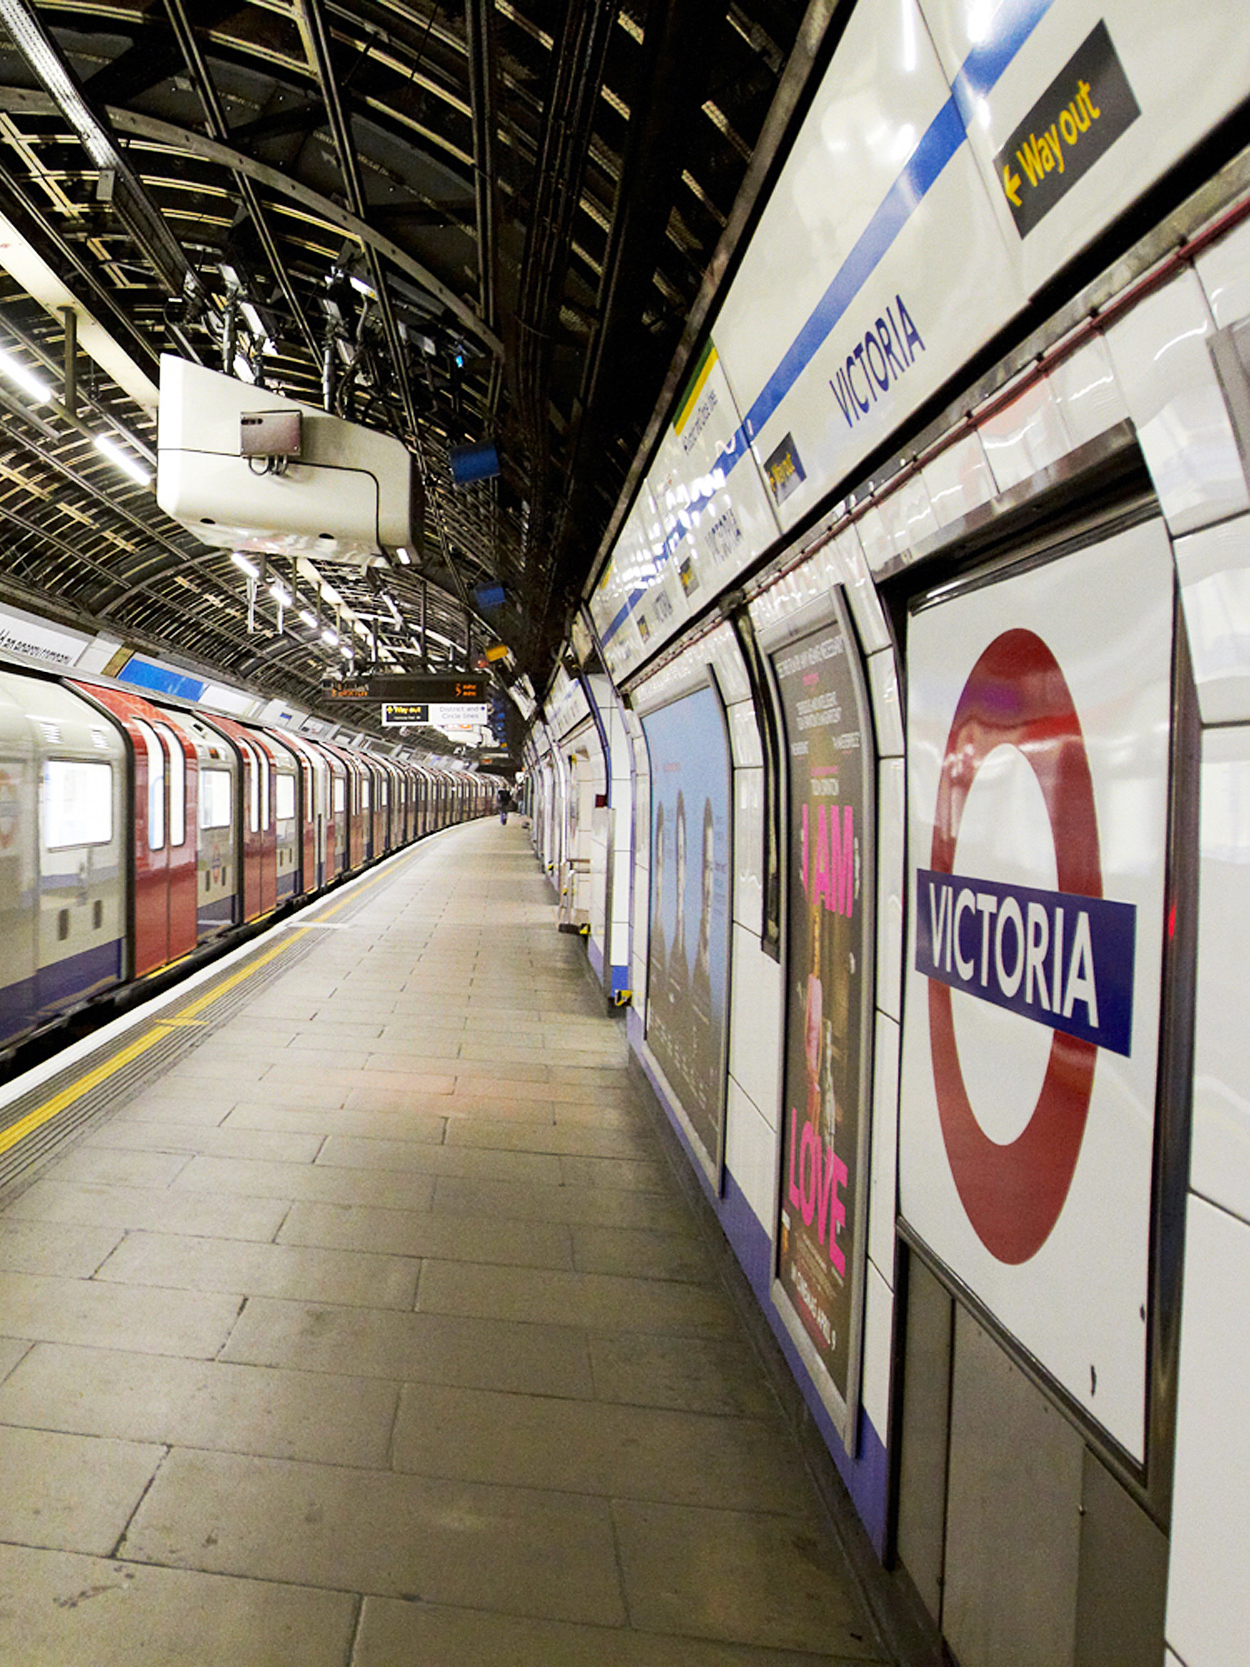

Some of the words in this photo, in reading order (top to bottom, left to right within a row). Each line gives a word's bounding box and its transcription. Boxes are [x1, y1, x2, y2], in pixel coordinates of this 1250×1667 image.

[1016, 124, 1065, 187] Way
[1059, 80, 1100, 145] out
[829, 294, 925, 428] VICTORIA
[409, 706, 422, 714] out
[929, 882, 1099, 1029] VICTORIA
[788, 1106, 848, 1278] LOVE
